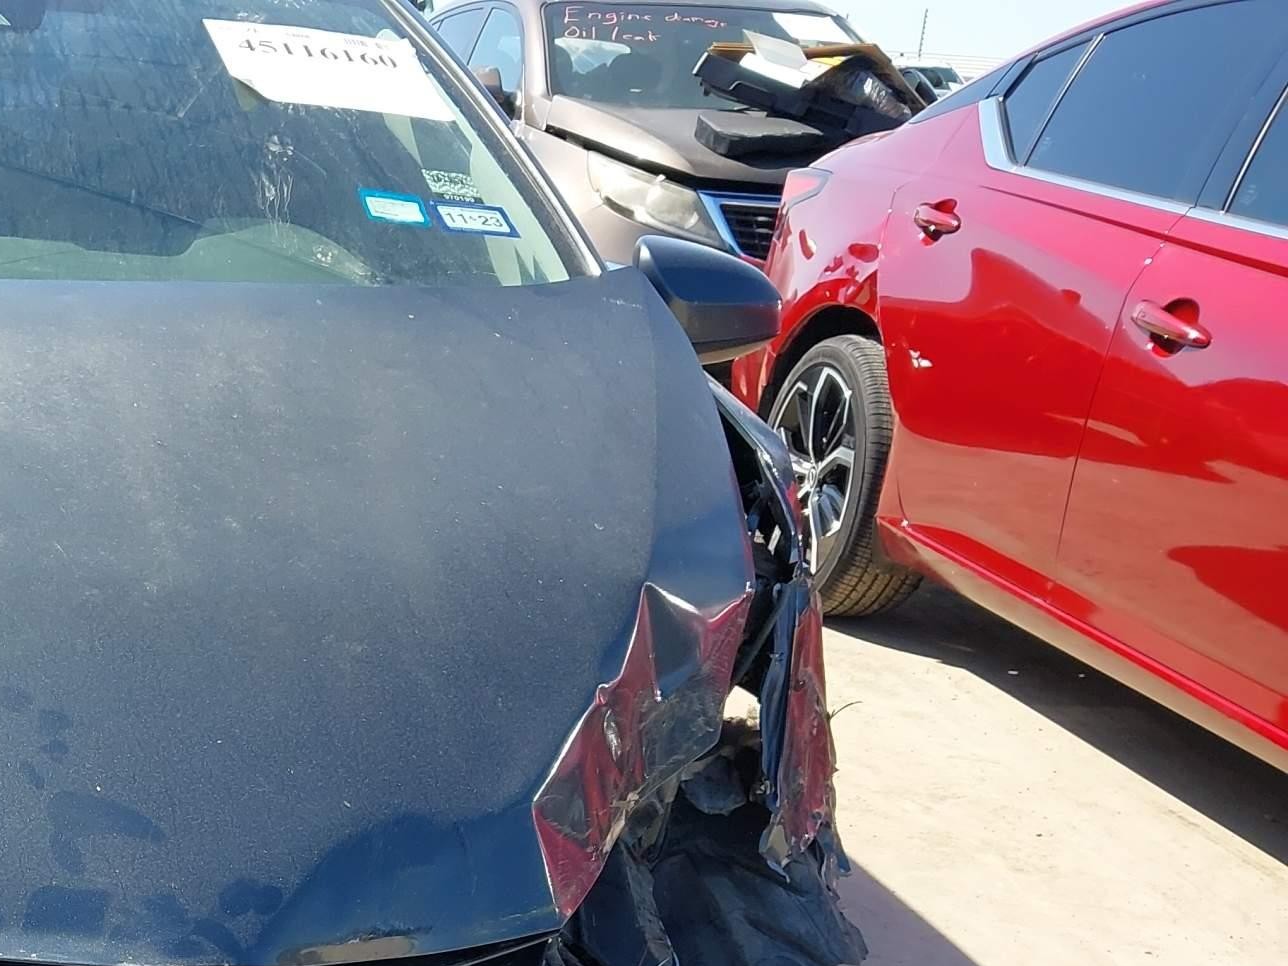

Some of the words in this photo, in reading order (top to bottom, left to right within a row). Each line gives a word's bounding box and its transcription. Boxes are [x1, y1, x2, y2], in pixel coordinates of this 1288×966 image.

[564, 6, 652, 24] Engine
[564, 26, 596, 40] Oil
[238, 38, 398, 69] 45116160
